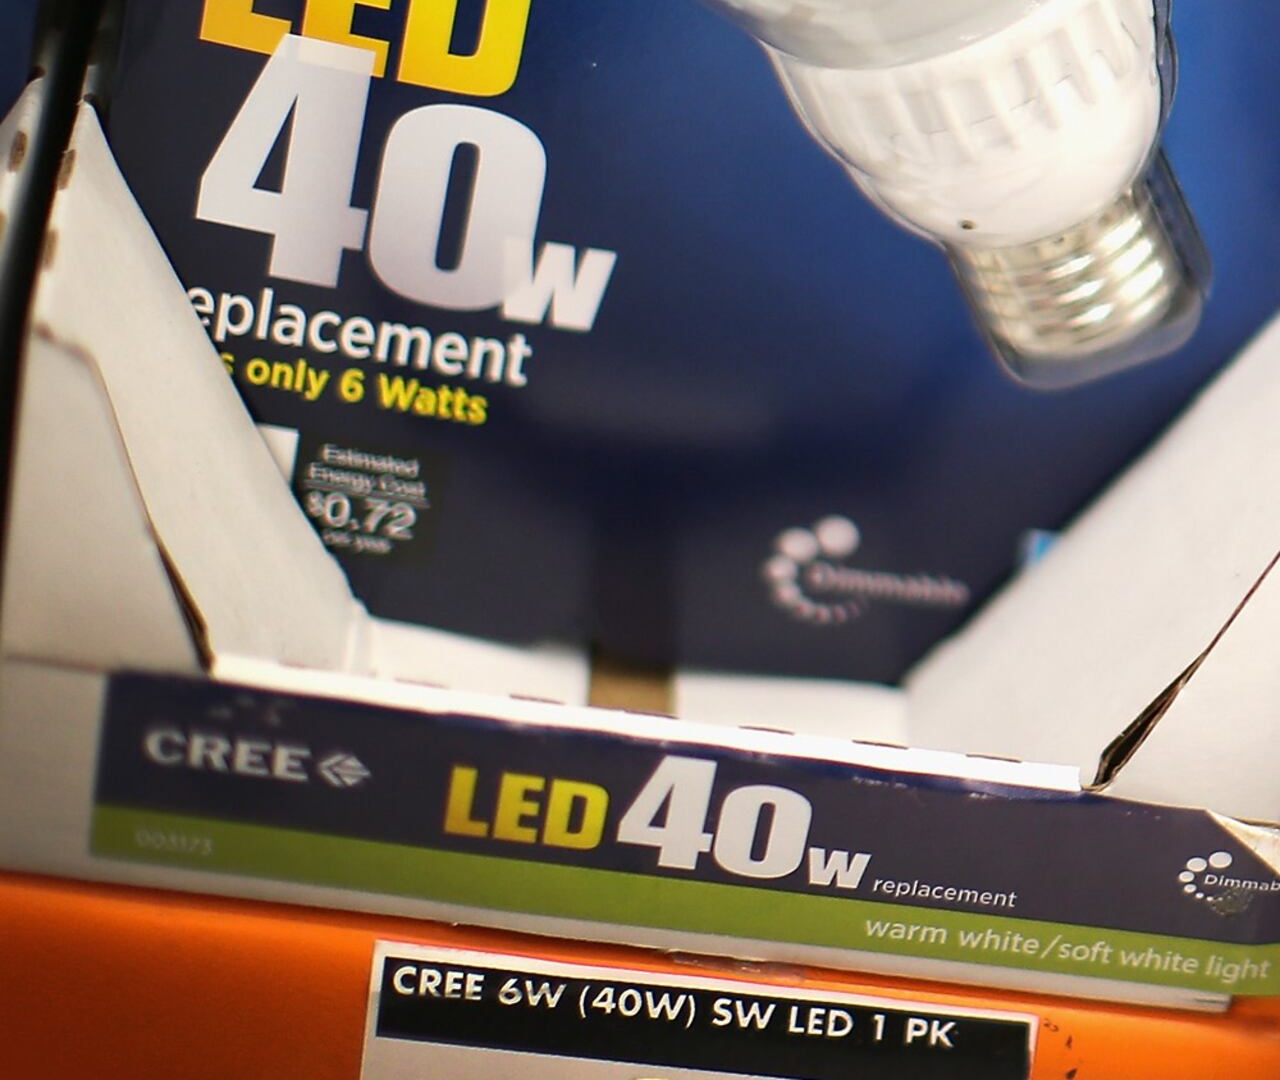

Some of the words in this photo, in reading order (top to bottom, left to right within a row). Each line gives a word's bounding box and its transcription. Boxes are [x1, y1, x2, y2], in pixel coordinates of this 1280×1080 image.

[187, 287, 531, 387] eplacement
[246, 356, 329, 401] only
[340, 369, 365, 403] 6
[378, 373, 488, 425] Watts
[144, 727, 310, 783] CREE
[444, 765, 609, 850] LED
[872, 875, 1016, 909] replacement
[865, 917, 948, 948] warm
[1120, 946, 1198, 976] white
[1205, 953, 1271, 984] light
[393, 965, 482, 1001] CREE
[499, 978, 566, 1009] 6W
[578, 985, 697, 1029] (40W)
[712, 998, 775, 1031] SW
[789, 1005, 853, 1038] LED
[873, 1014, 885, 1041] 1
[905, 1019, 957, 1048] PK
